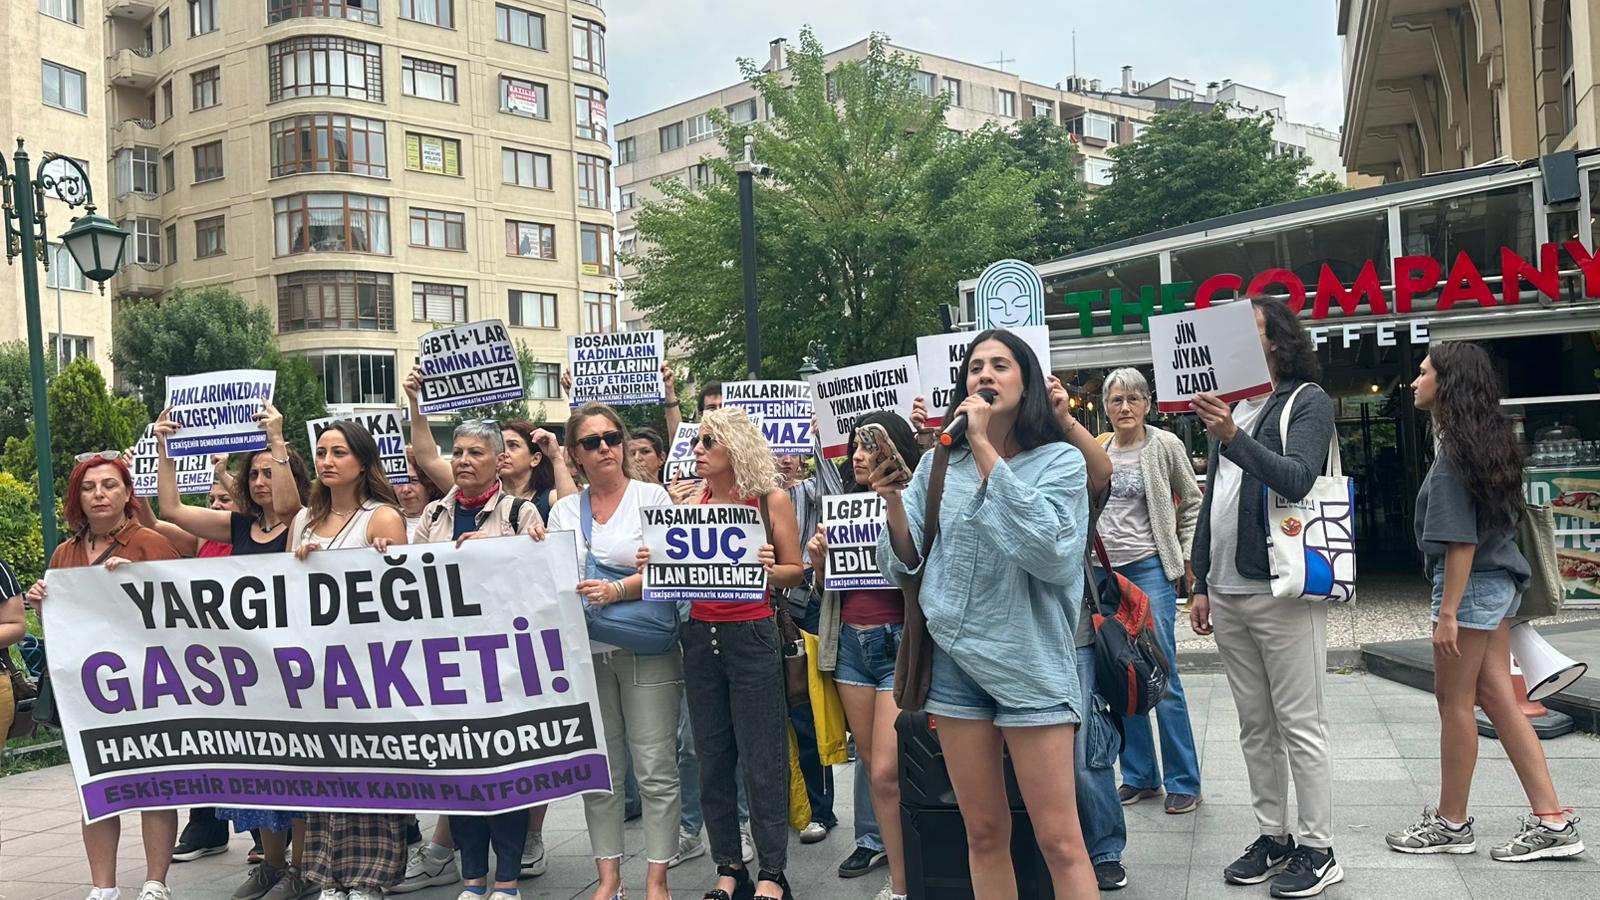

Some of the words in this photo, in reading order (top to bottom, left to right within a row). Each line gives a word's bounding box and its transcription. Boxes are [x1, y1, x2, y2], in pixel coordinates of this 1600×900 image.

[1064, 281, 1193, 338] THE
[1194, 240, 1600, 321] COMPANY
[1175, 320, 1197, 345] JİN
[1311, 318, 1430, 351] FFEE
[578, 345, 656, 361] KADINLARIN
[949, 343, 970, 362] KA
[1172, 345, 1213, 370] JİYAN
[576, 358, 657, 376] HAKLARINI
[576, 376, 604, 386] GASP
[608, 373, 657, 384] ETMEDEN
[170, 382, 272, 406] HAKLARIMIZDAN
[424, 367, 517, 399] EDİLEMEZ!
[575, 383, 659, 397] HIZLANDIRIN!
[726, 384, 811, 399] HAKLARIMIZ
[817, 375, 863, 399] ÖLDÜREN
[864, 364, 908, 390] DÜZENİ
[1176, 367, 1218, 396] AZADÎ
[829, 394, 871, 416] YIKMAK
[872, 388, 898, 411] İÇİN
[762, 423, 811, 444] MAZ
[644, 507, 761, 529] YAŞAMLARIMIZ
[665, 526, 747, 565] SUÇ
[834, 546, 877, 572] EDİL
[650, 564, 686, 585] İLAN
[688, 564, 763, 586] EDİLEMEZ
[120, 574, 289, 630] YARGI
[308, 552, 482, 626] DEĞİL
[650, 589, 681, 600] ESKİŞEHİR
[682, 590, 716, 600] DEMOKRATİK
[717, 591, 734, 600] KADIN
[735, 592, 763, 600] PLATFORMU
[81, 644, 259, 715] GASP
[273, 616, 570, 710] PAKETİ!
[96, 730, 325, 765] HAKLARIMIZDAN
[328, 717, 584, 767] VAZGEÇMİYORUZ
[103, 774, 224, 804] ESKİŞEHİR
[229, 776, 361, 798] DEMOKRATİK
[366, 780, 436, 800] KADIN
[440, 763, 592, 801] PLATFORMU
